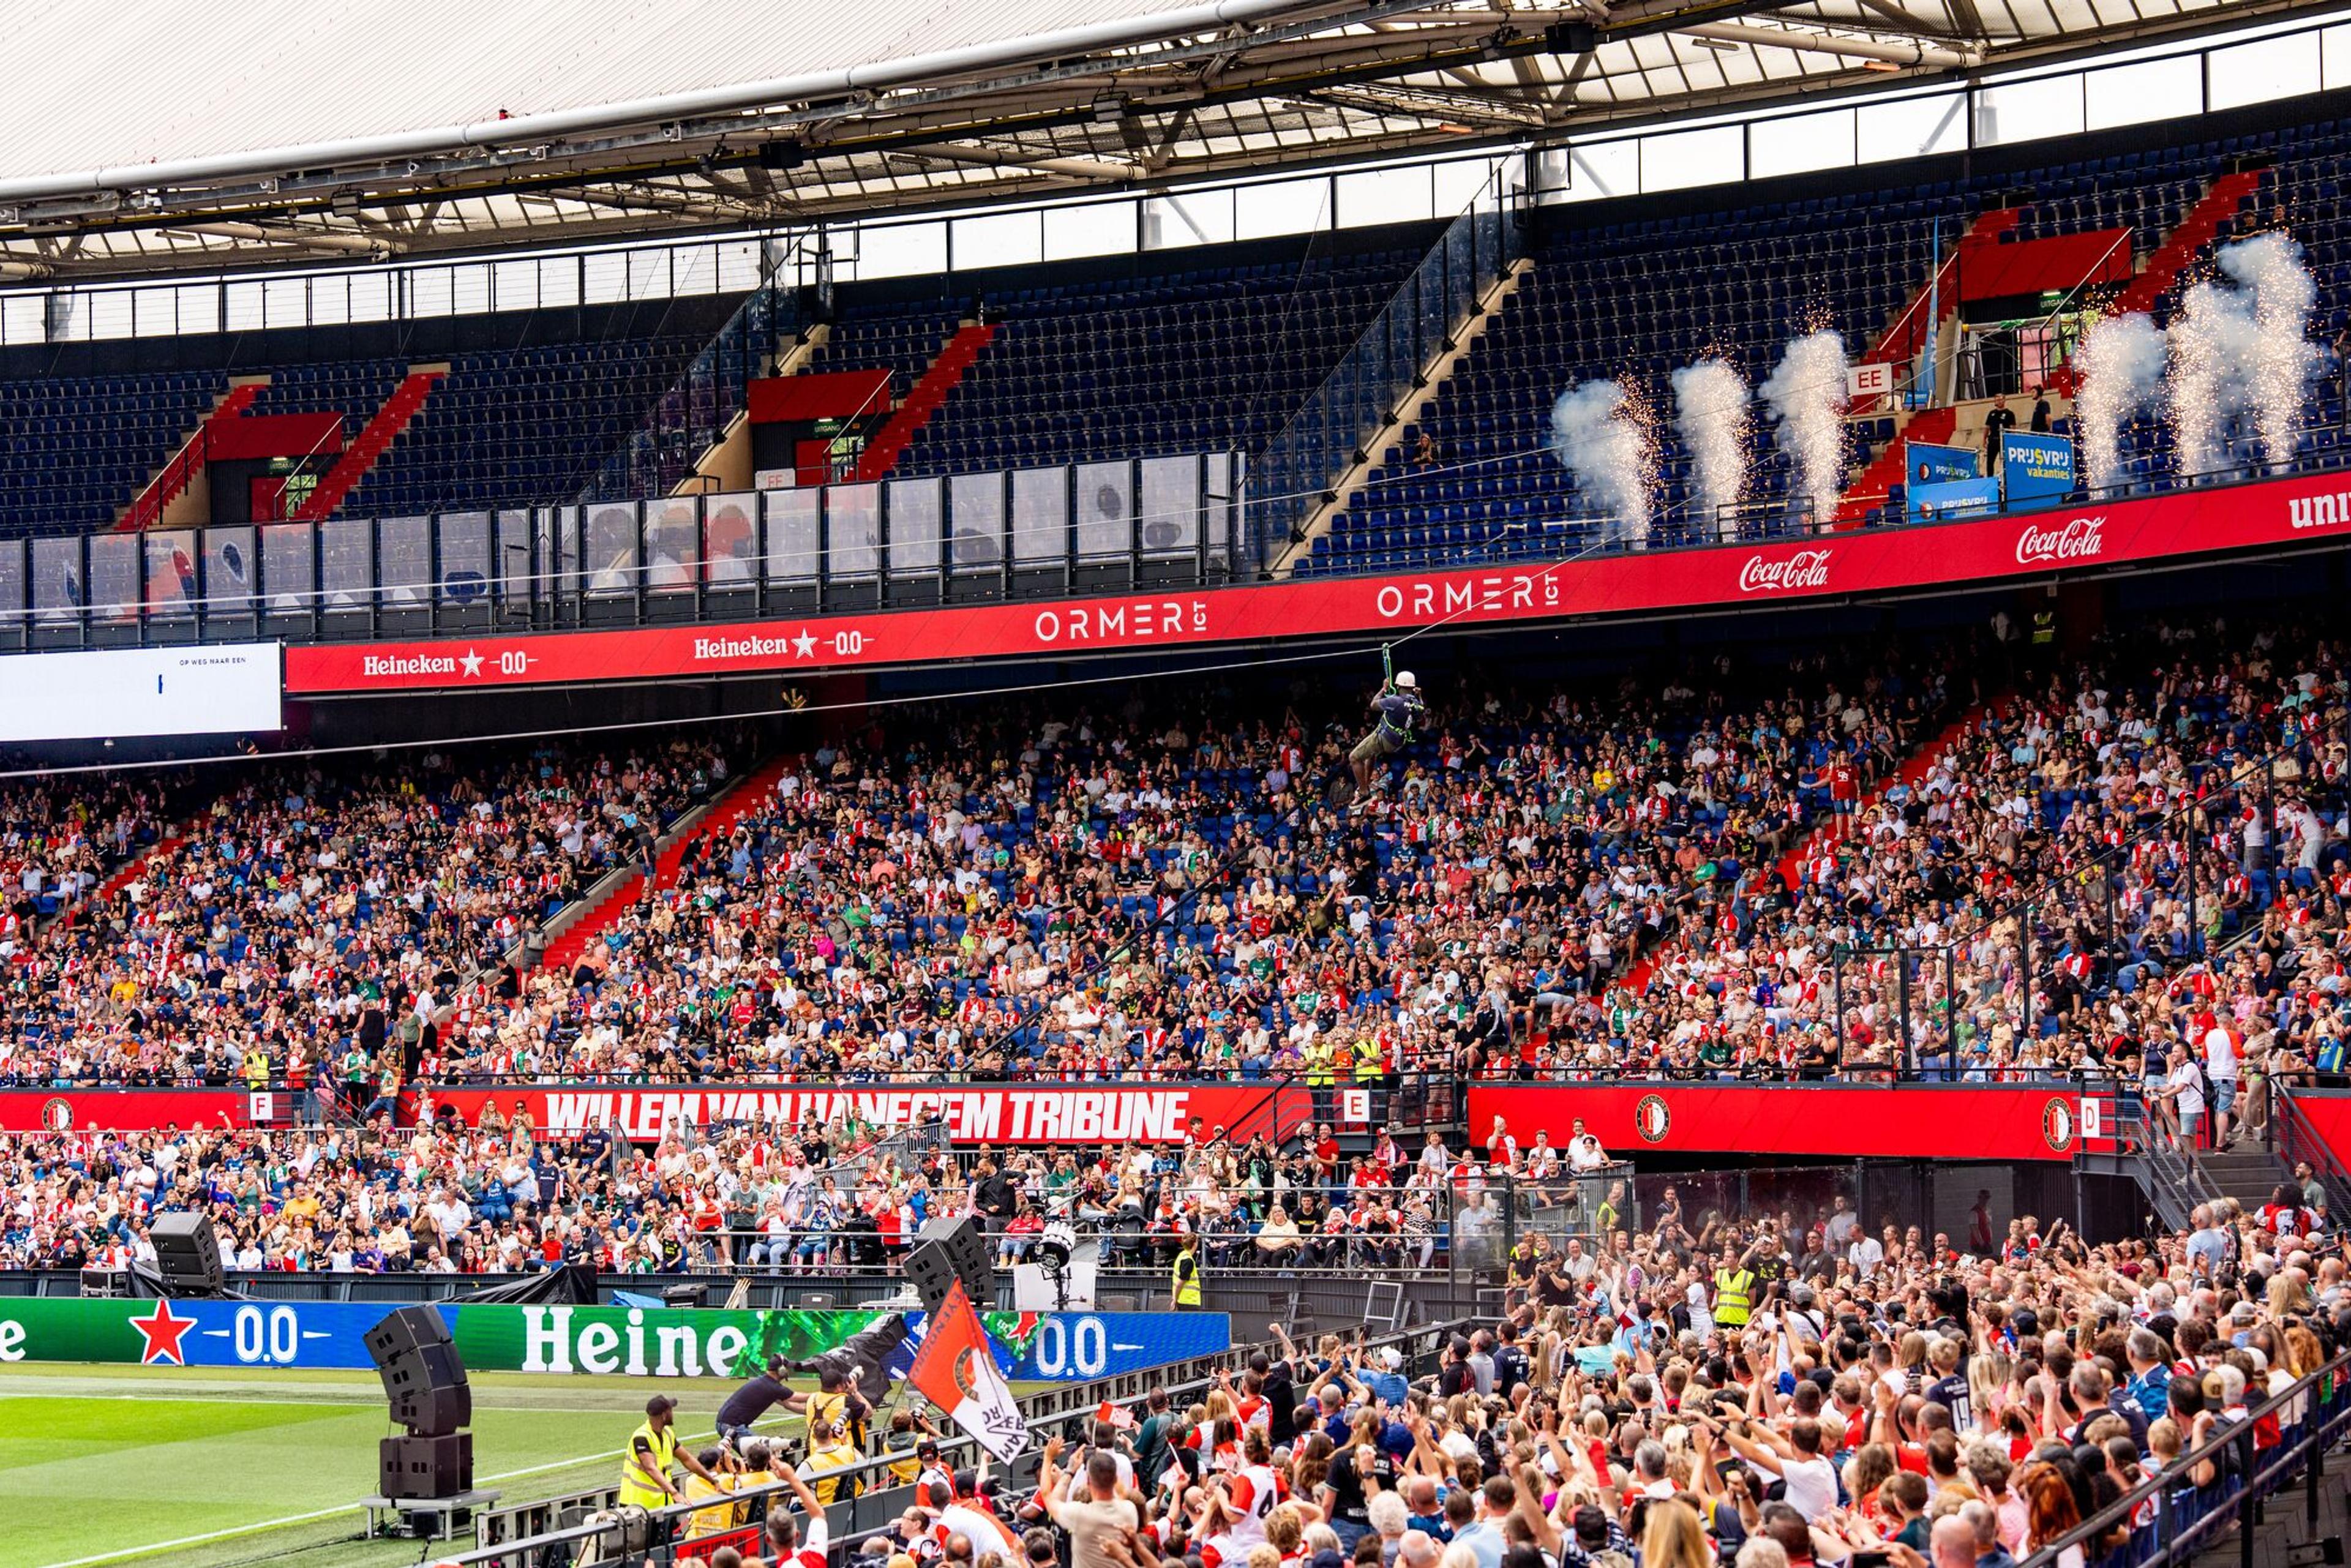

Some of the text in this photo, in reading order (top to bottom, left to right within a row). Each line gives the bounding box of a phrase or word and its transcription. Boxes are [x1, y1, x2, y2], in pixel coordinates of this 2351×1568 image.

[1858, 370, 1882, 388] EE
[2027, 466, 2070, 480] vakanties
[2289, 491, 2351, 528] uni
[2016, 517, 2107, 564] Coca-Cola
[1739, 549, 1832, 591] Coca-Cola
[1377, 574, 1559, 618] ORMER ICT
[1035, 601, 1206, 642] ORMER ICT
[694, 631, 862, 659] Heineken 0.0
[364, 651, 527, 675] Heineken 0.0
[256, 1097, 266, 1114] F
[545, 1092, 704, 1139] WILLEM
[705, 1092, 797, 1134] VAN
[1008, 1092, 1190, 1139] TRIBUNE
[1351, 1095, 1362, 1116] E
[2086, 1106, 2095, 1129] D
[235, 1305, 298, 1363] 0.0
[1036, 1315, 1106, 1377] 0.0
[1257, 1489, 1273, 1518] 4
